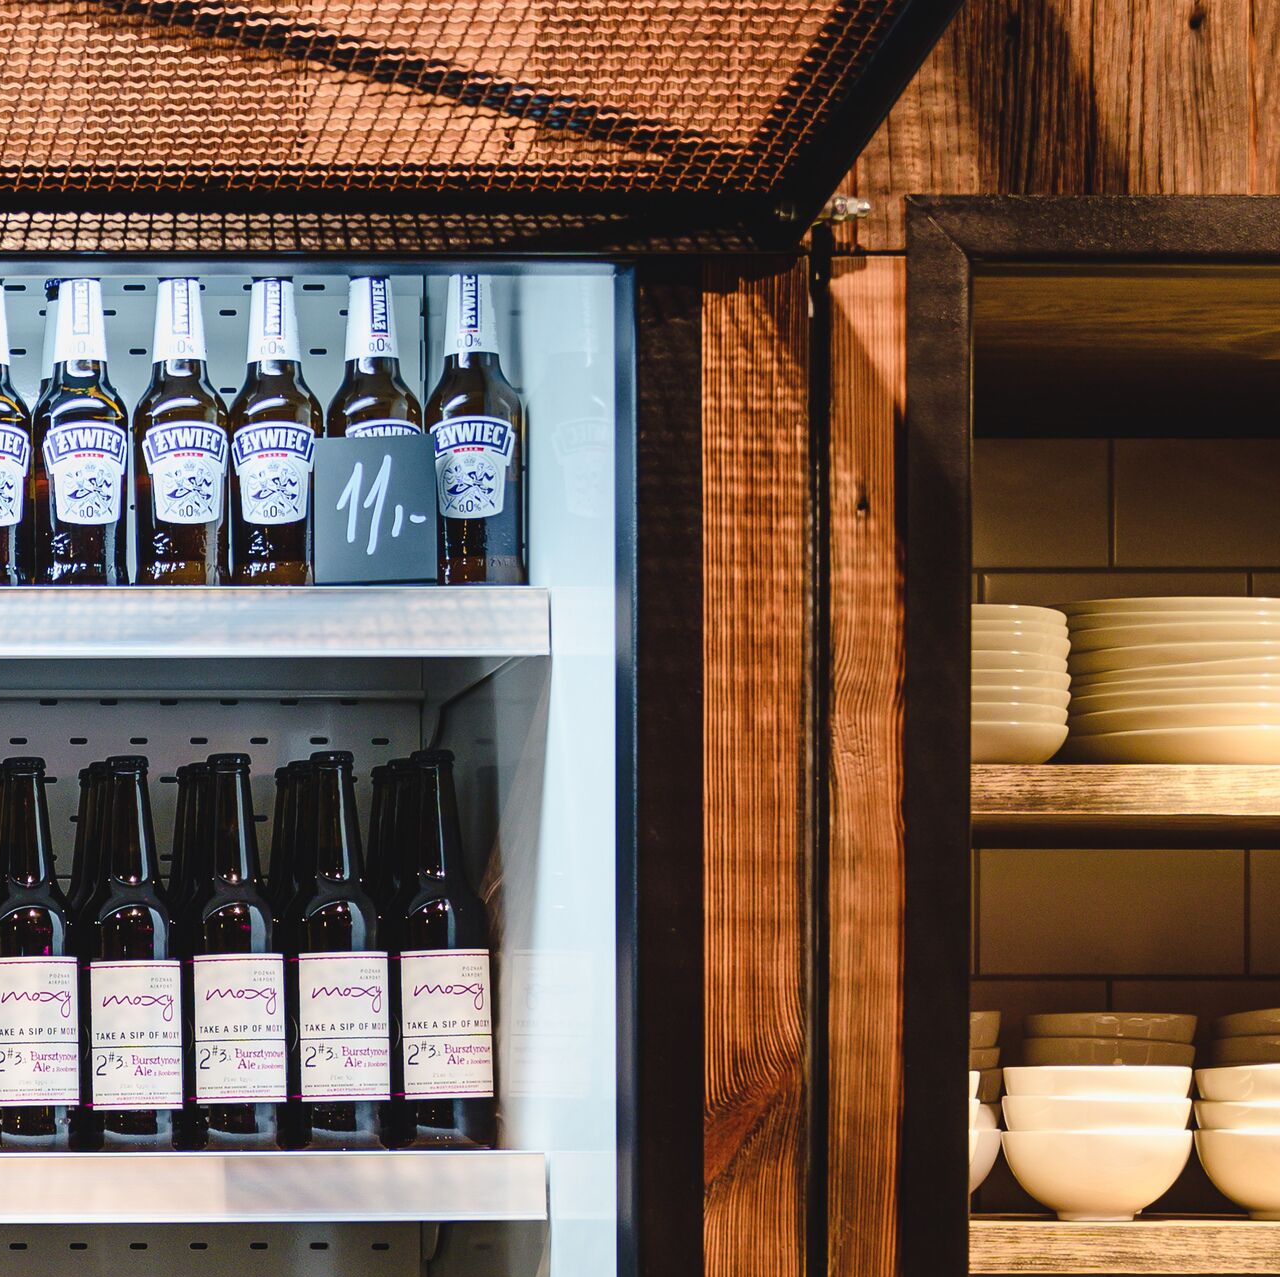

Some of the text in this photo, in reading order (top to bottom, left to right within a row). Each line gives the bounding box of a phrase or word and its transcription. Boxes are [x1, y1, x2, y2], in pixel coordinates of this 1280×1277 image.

[155, 428, 220, 452] ŻYWIEC
[247, 428, 308, 452] ŻYWIEC
[437, 424, 504, 447] ŻYWIEC
[413, 983, 484, 1010] moxy
